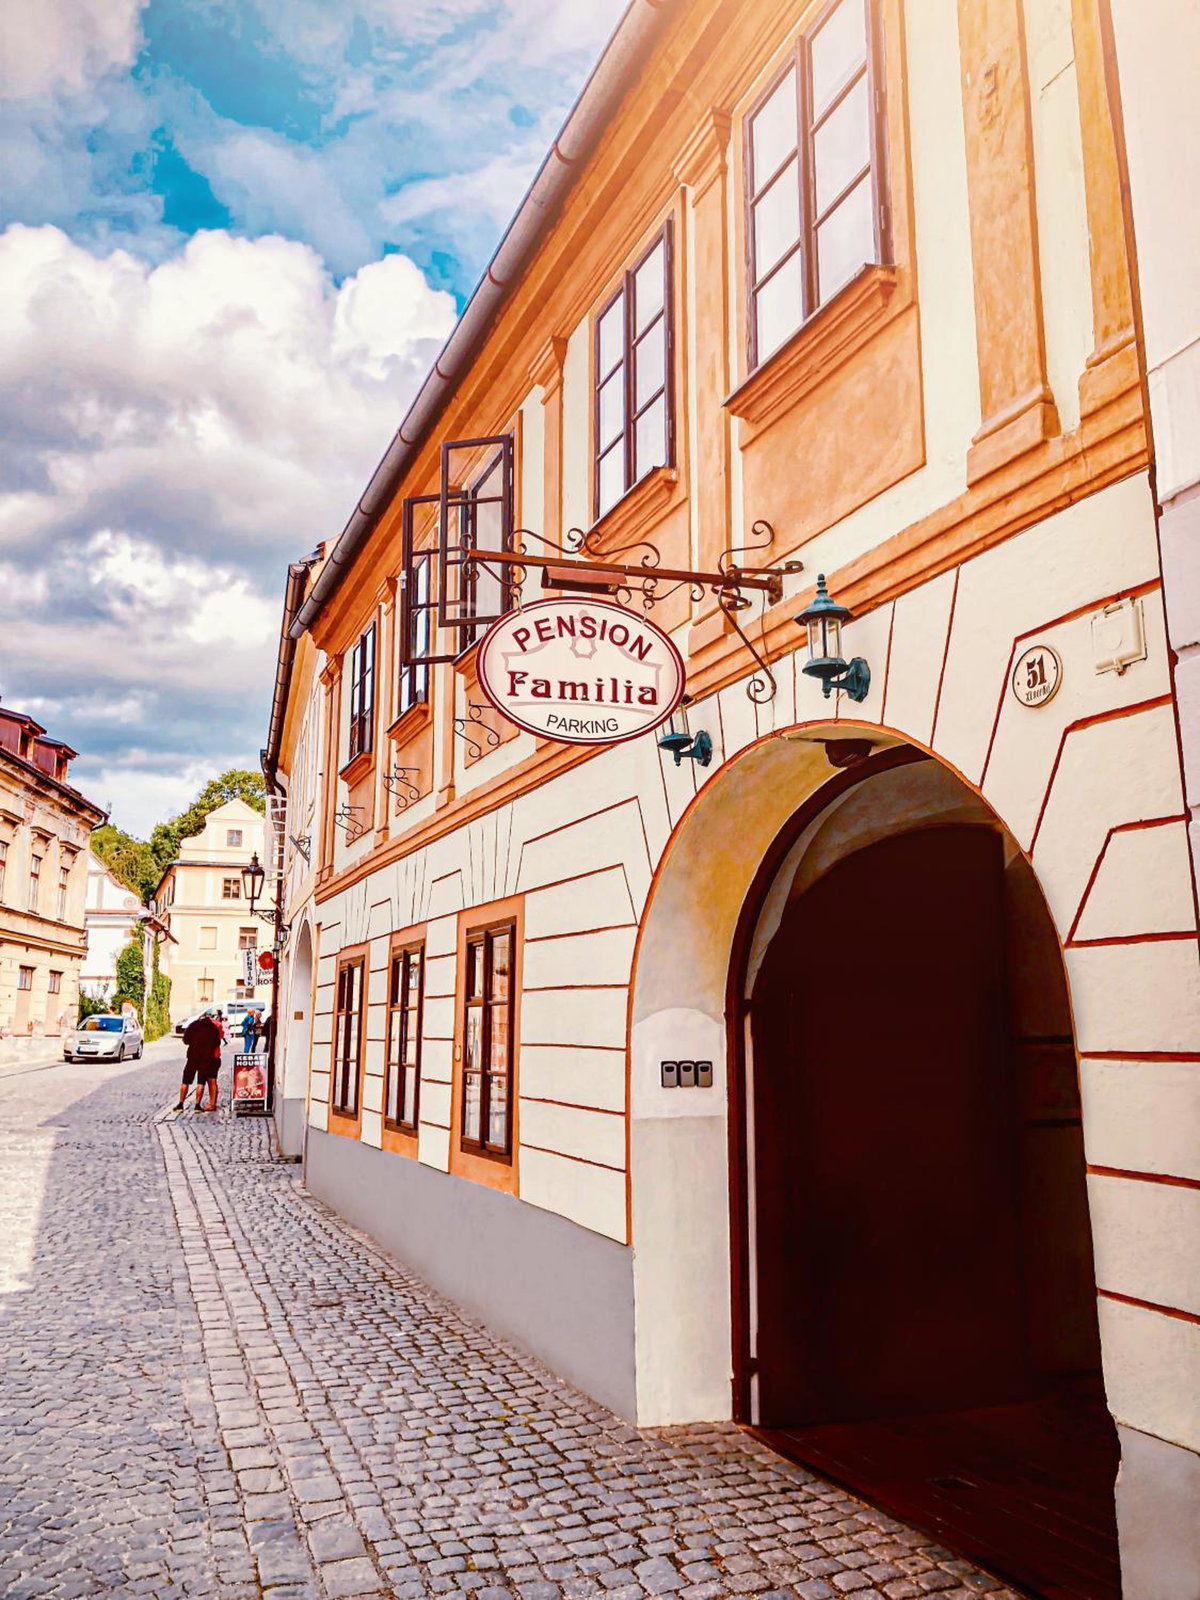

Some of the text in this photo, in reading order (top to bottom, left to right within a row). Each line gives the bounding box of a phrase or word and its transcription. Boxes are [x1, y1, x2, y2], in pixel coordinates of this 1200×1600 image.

[512, 615, 653, 661] PENSION
[506, 670, 658, 705] Familia
[1026, 654, 1047, 689] 51
[546, 714, 619, 734] PARKING
